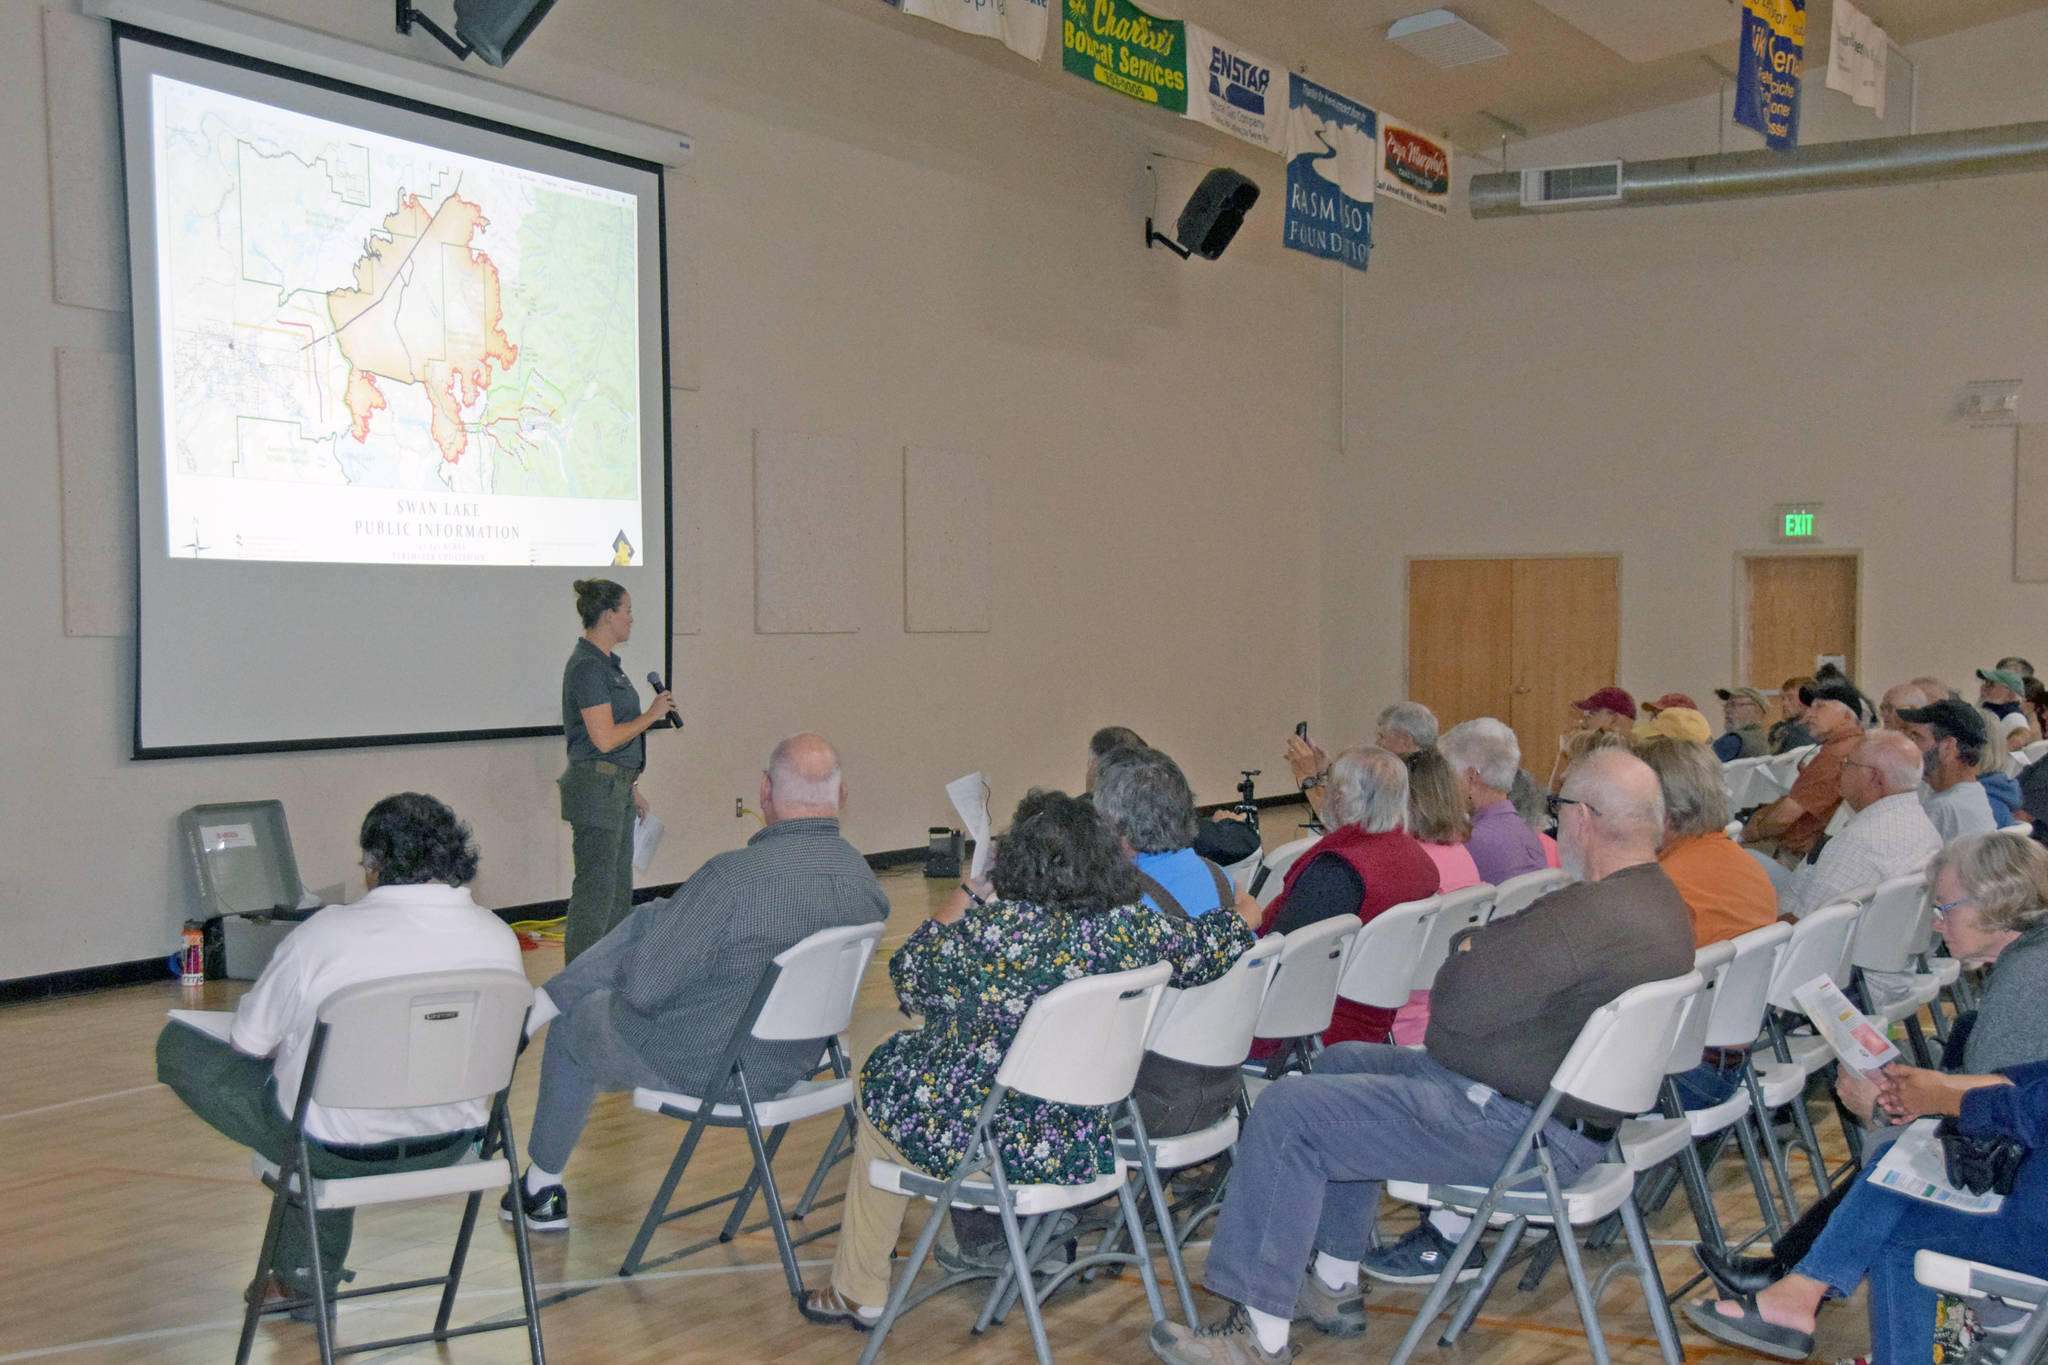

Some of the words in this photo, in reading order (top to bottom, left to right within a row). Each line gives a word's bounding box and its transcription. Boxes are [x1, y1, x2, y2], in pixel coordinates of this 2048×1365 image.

[1118, 45, 1185, 91] Services
[1208, 46, 1270, 95] ENSTAR
[397, 499, 438, 516] SWAN
[444, 501, 481, 517] LAKE
[355, 520, 412, 537] PUBLIC
[418, 522, 521, 540] INFORMATION
[1785, 513, 1814, 536] EXIT
